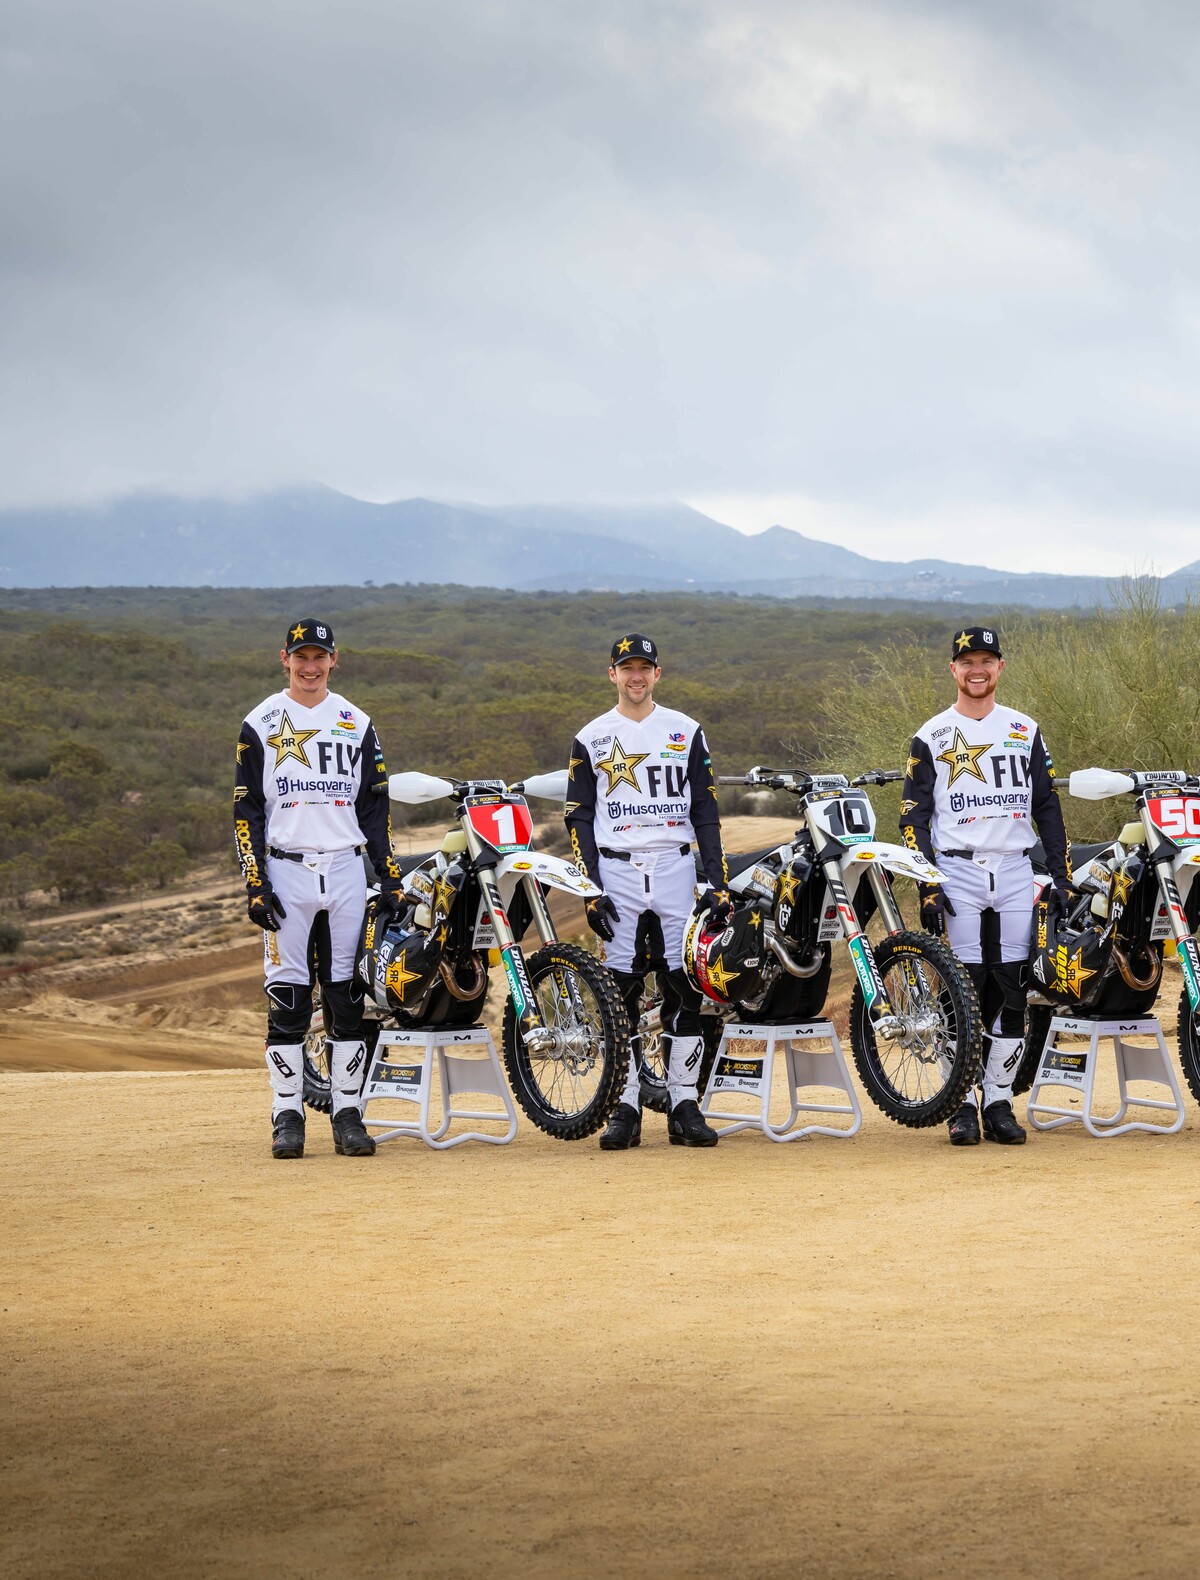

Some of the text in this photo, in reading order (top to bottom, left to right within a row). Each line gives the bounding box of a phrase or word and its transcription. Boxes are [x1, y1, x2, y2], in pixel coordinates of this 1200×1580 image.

[1010, 722, 1022, 731] VP
[670, 733, 682, 742] VP
[317, 742, 362, 778] FLY
[291, 780, 352, 795] Husqvarna
[967, 794, 1028, 808] Husqvarna
[492, 806, 516, 844] 1
[824, 800, 871, 836] 10
[893, 946, 922, 954] DUNLOP
[551, 958, 578, 971] DUNLOP
[861, 938, 887, 996] DUNLOP
[1056, 945, 1068, 993] 100%
[510, 948, 536, 1008] DUNLOP
[856, 958, 873, 996] MOTOREX
[1181, 962, 1197, 1001] MOTOREX
[507, 970, 523, 1008] MOTOREX
[1059, 1056, 1081, 1065] ROCKSTAR
[391, 1069, 415, 1077] ROCKSTAR
[1041, 1070, 1050, 1078] 50
[369, 1083, 376, 1092] 1
[714, 1077, 723, 1087] 10
